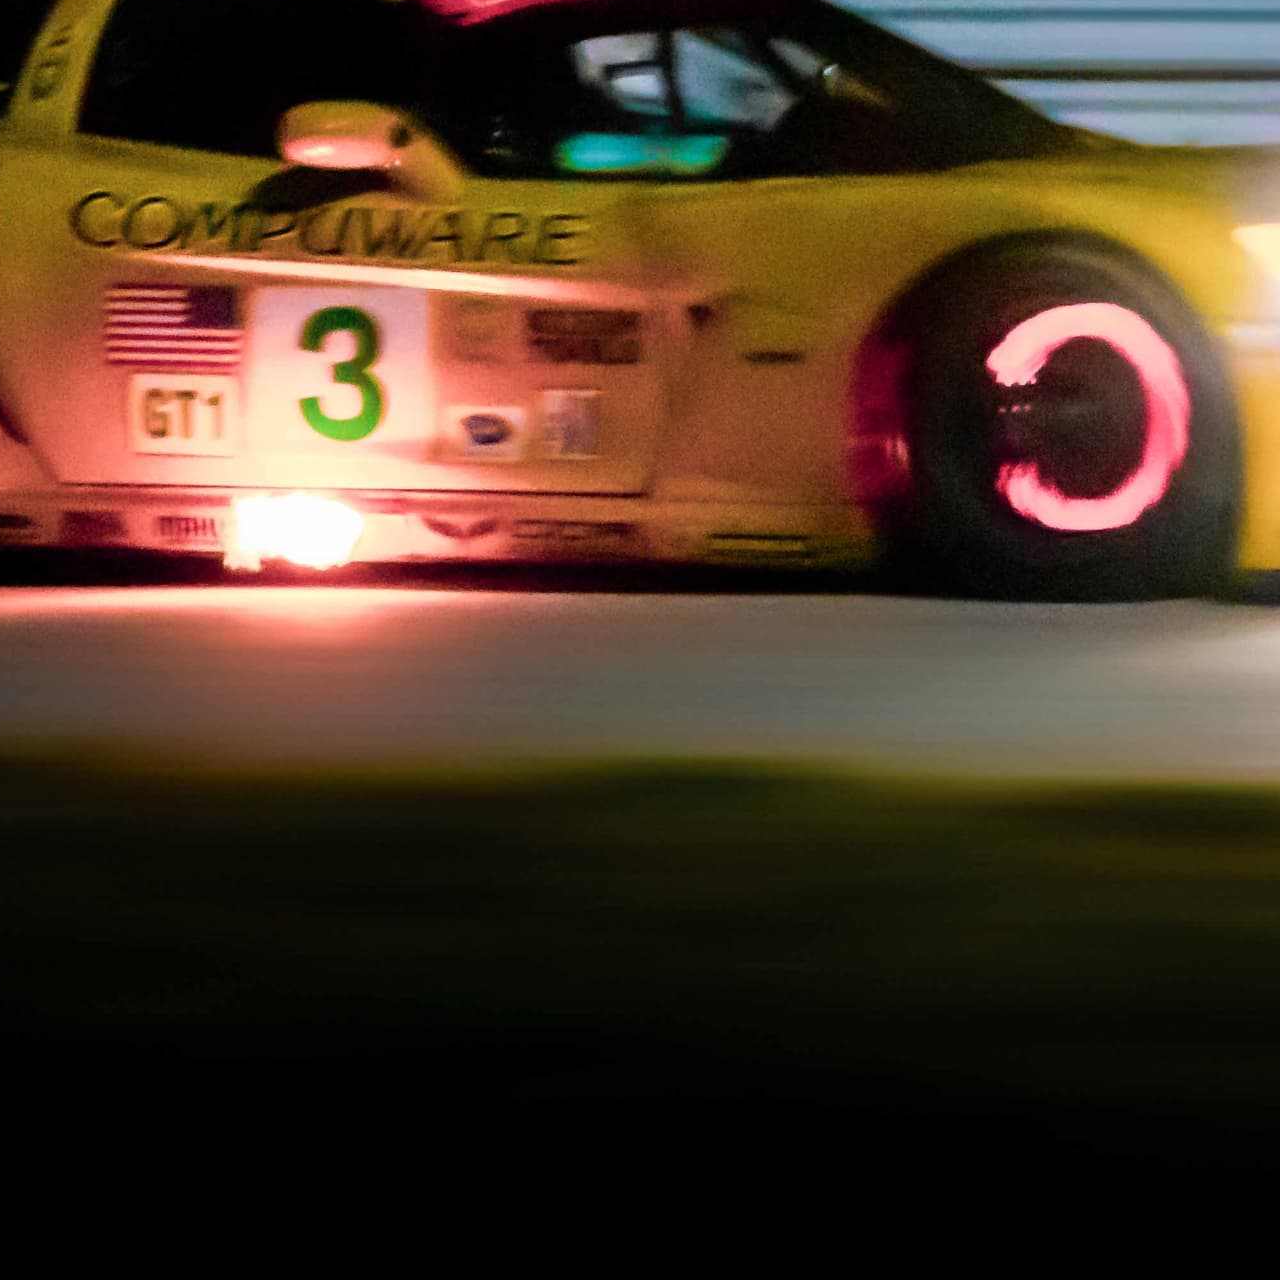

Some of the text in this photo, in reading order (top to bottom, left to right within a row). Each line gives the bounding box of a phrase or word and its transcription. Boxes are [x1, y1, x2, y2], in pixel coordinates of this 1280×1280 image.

[72, 191, 588, 264] COMPUWARE
[299, 306, 384, 441] 3
[145, 389, 224, 438] GT1
